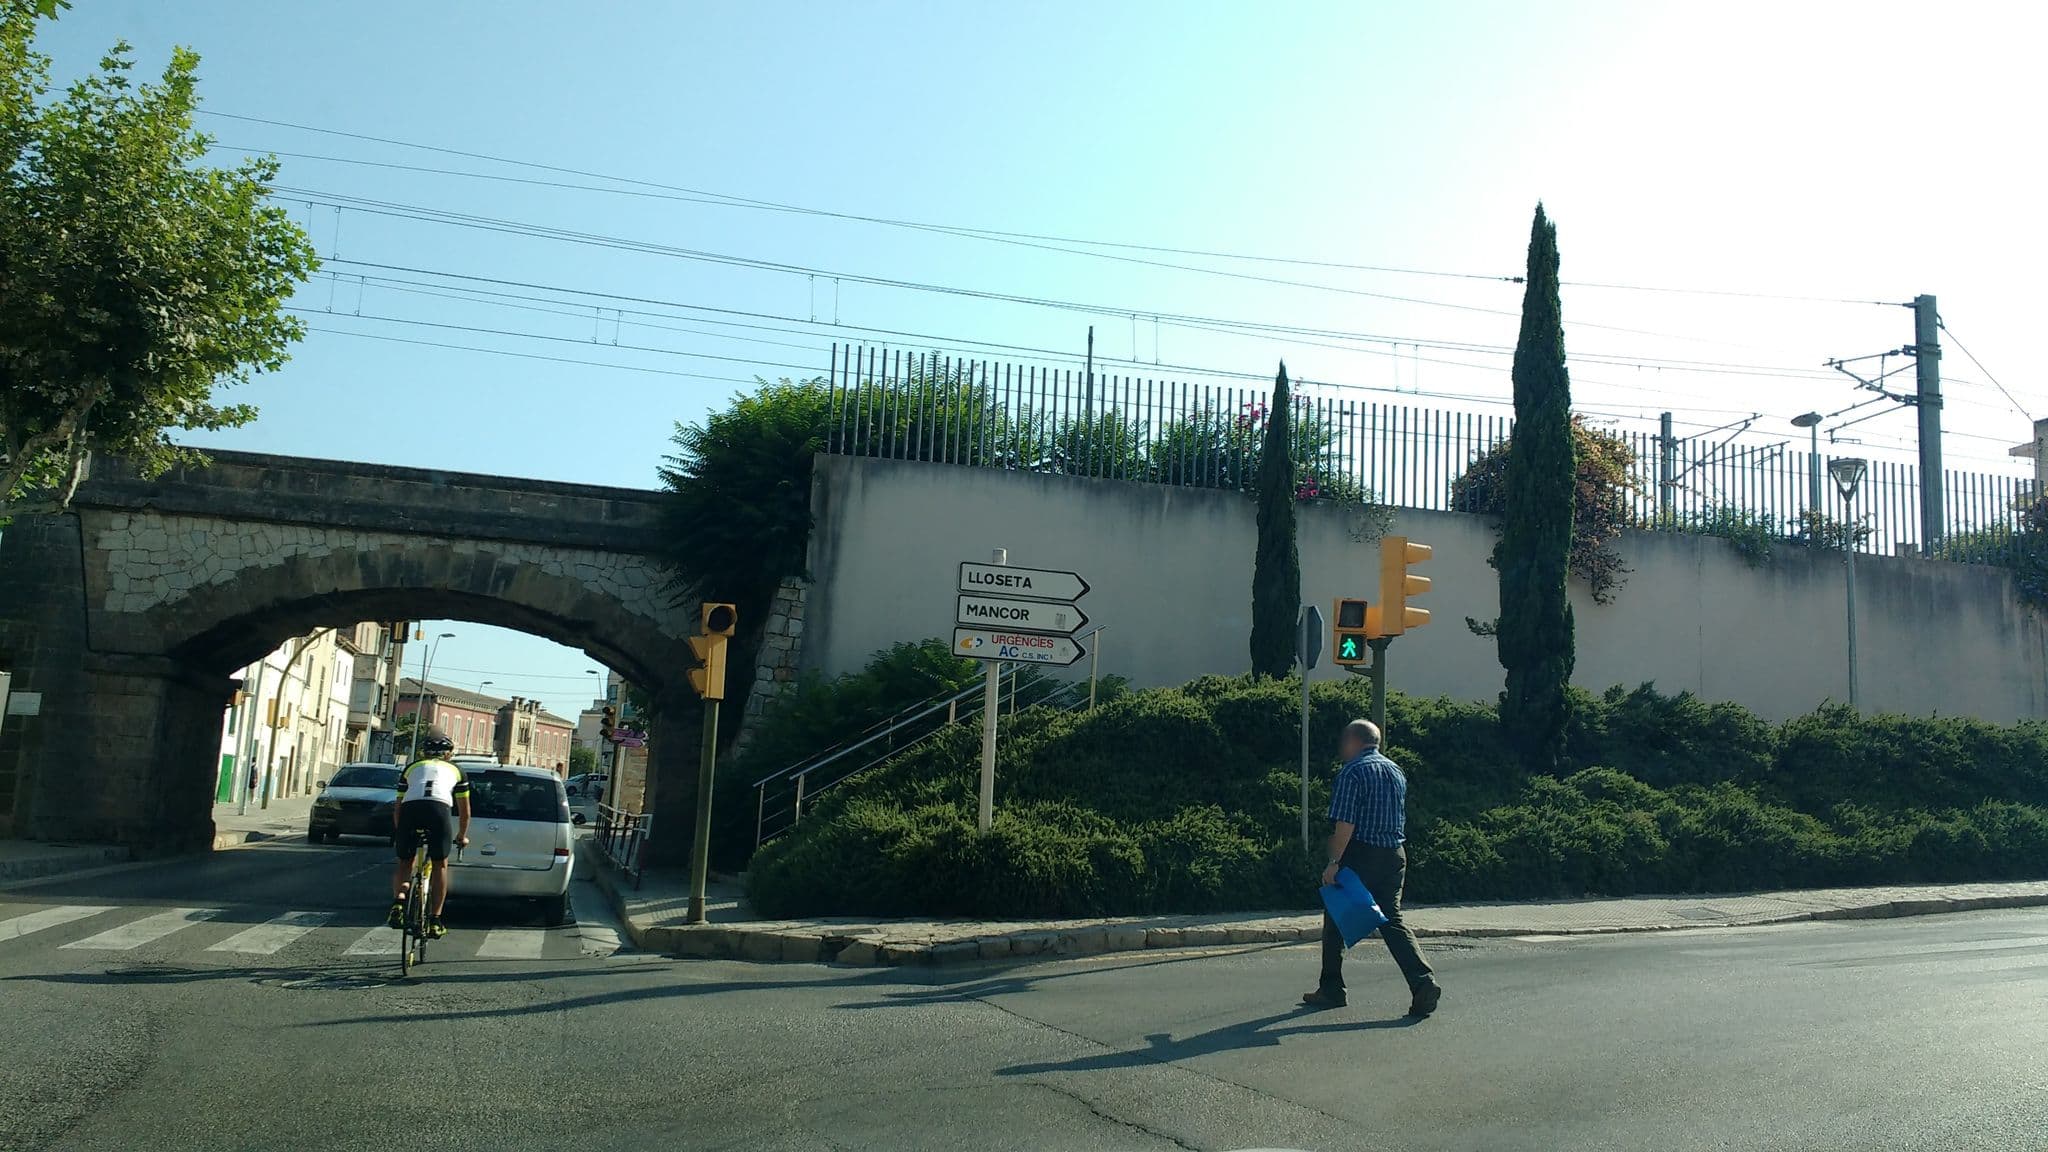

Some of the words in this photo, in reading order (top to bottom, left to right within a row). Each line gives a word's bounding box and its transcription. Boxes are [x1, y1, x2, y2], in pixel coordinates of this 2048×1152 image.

[968, 571, 1032, 589] LLOSETA
[966, 604, 1030, 621] MANCOR
[999, 645, 1019, 658] AC
